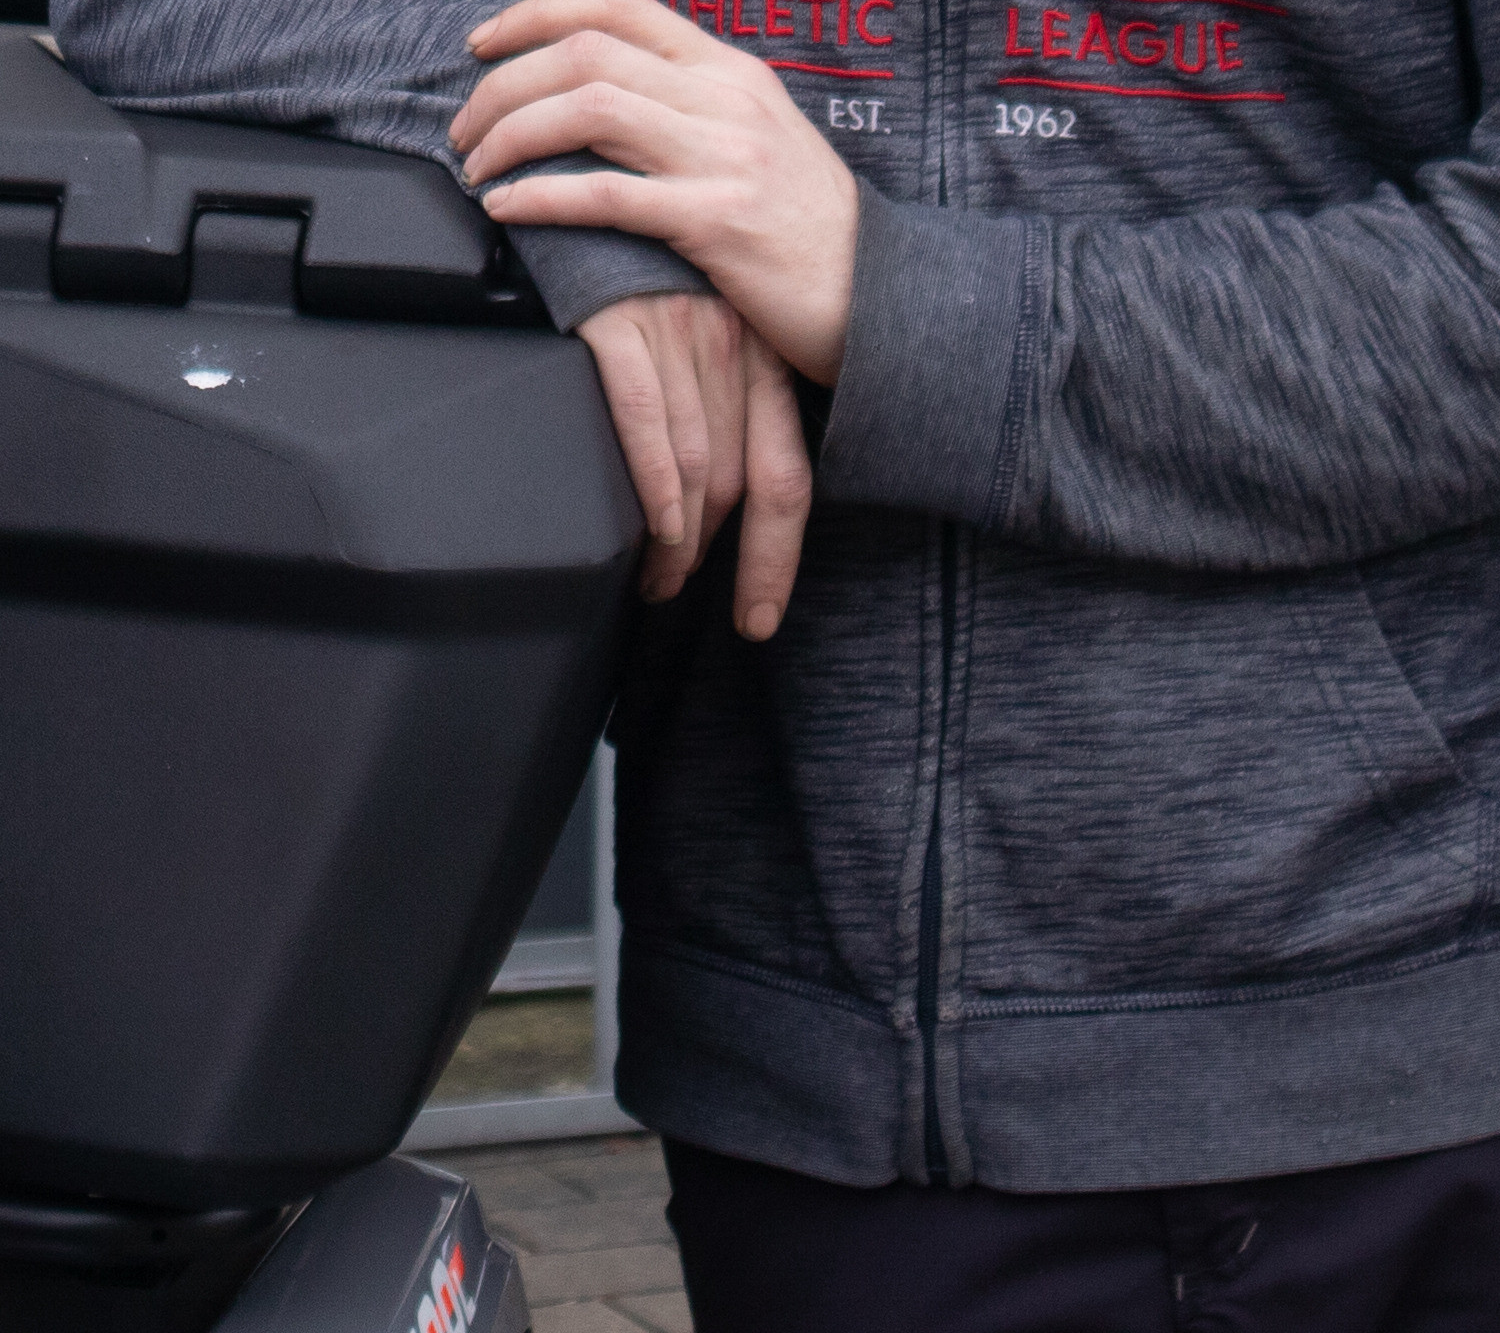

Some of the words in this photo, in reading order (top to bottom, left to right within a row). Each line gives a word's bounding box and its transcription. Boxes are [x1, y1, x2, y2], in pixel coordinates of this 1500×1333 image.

[1004, 6, 1244, 75] LEAGUE
[828, 99, 892, 134] EST.
[994, 102, 1079, 140] 1962
